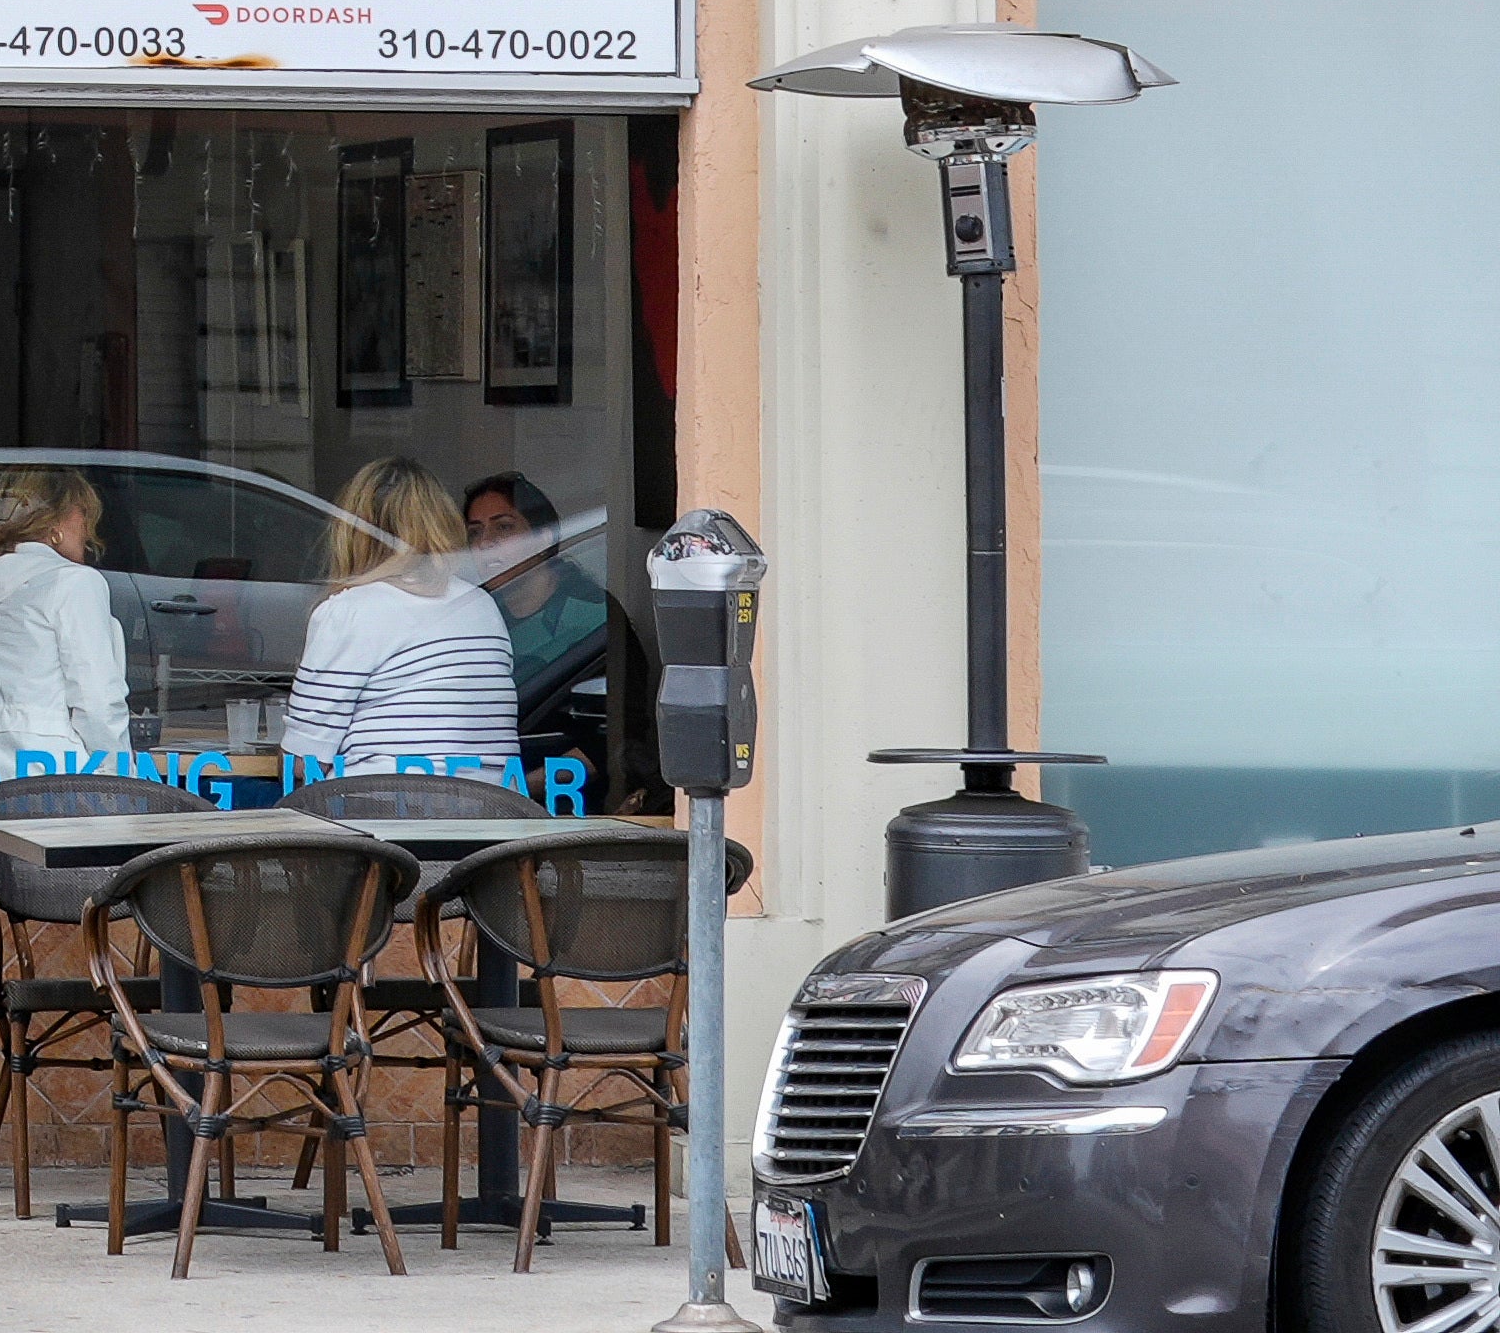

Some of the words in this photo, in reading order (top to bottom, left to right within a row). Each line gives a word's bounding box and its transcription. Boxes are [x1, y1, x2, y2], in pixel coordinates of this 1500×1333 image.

[237, 7, 372, 24] DOORDASH
[378, 28, 638, 63] 310-470-0022
[738, 593, 752, 607] WS
[736, 744, 749, 758] WS
